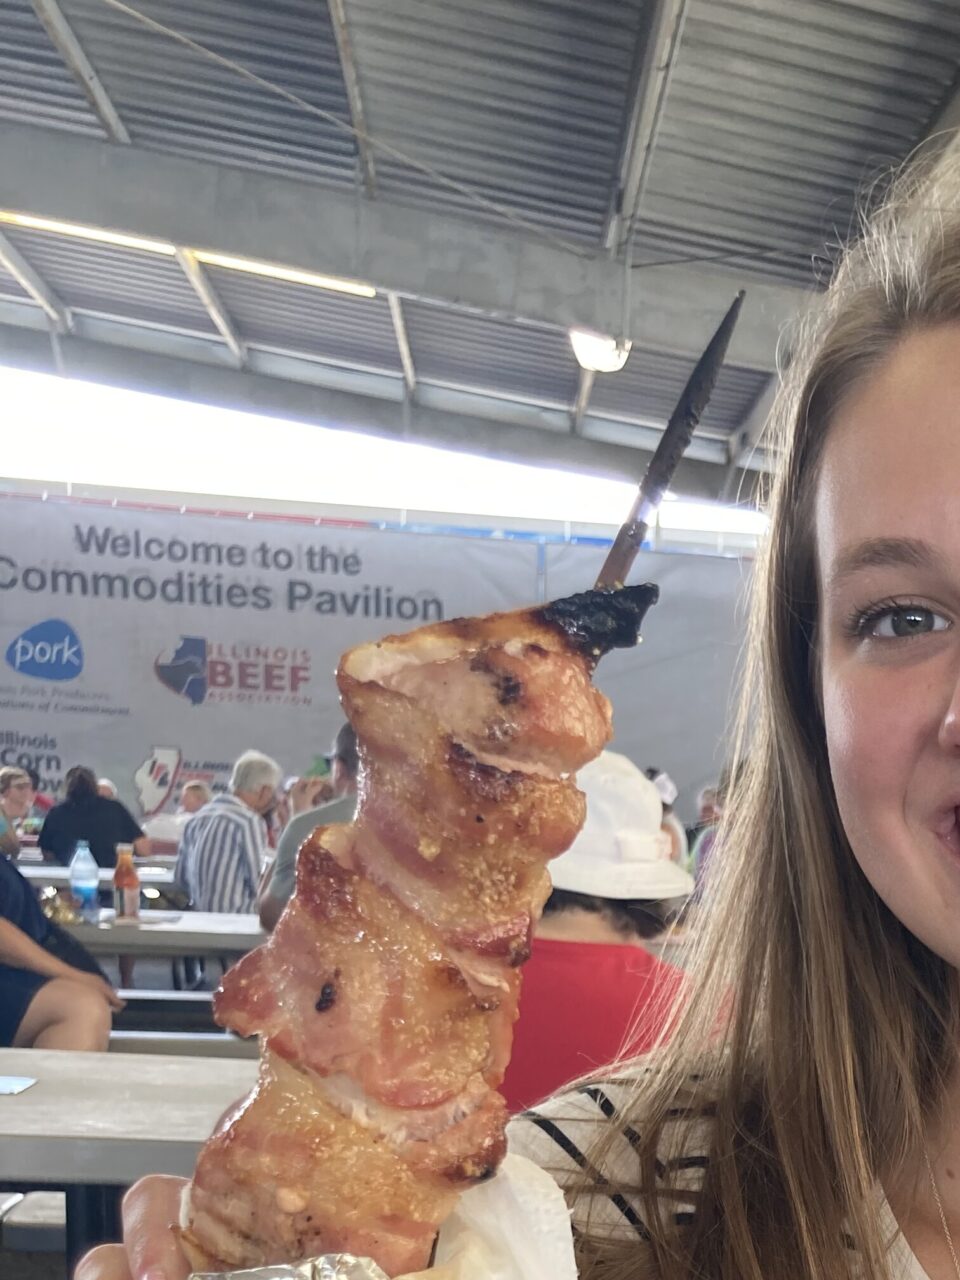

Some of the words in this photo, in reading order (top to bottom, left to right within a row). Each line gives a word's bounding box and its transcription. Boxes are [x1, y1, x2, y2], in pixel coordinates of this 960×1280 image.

[75, 524, 246, 567] Welcome
[261, 542, 293, 571] to
[306, 545, 362, 576] the
[287, 579, 444, 621] Pavilion
[14, 634, 80, 671] pork
[207, 643, 311, 664] ILLINOIS
[208, 660, 311, 692] BEEF
[0, 748, 61, 772] Corn
